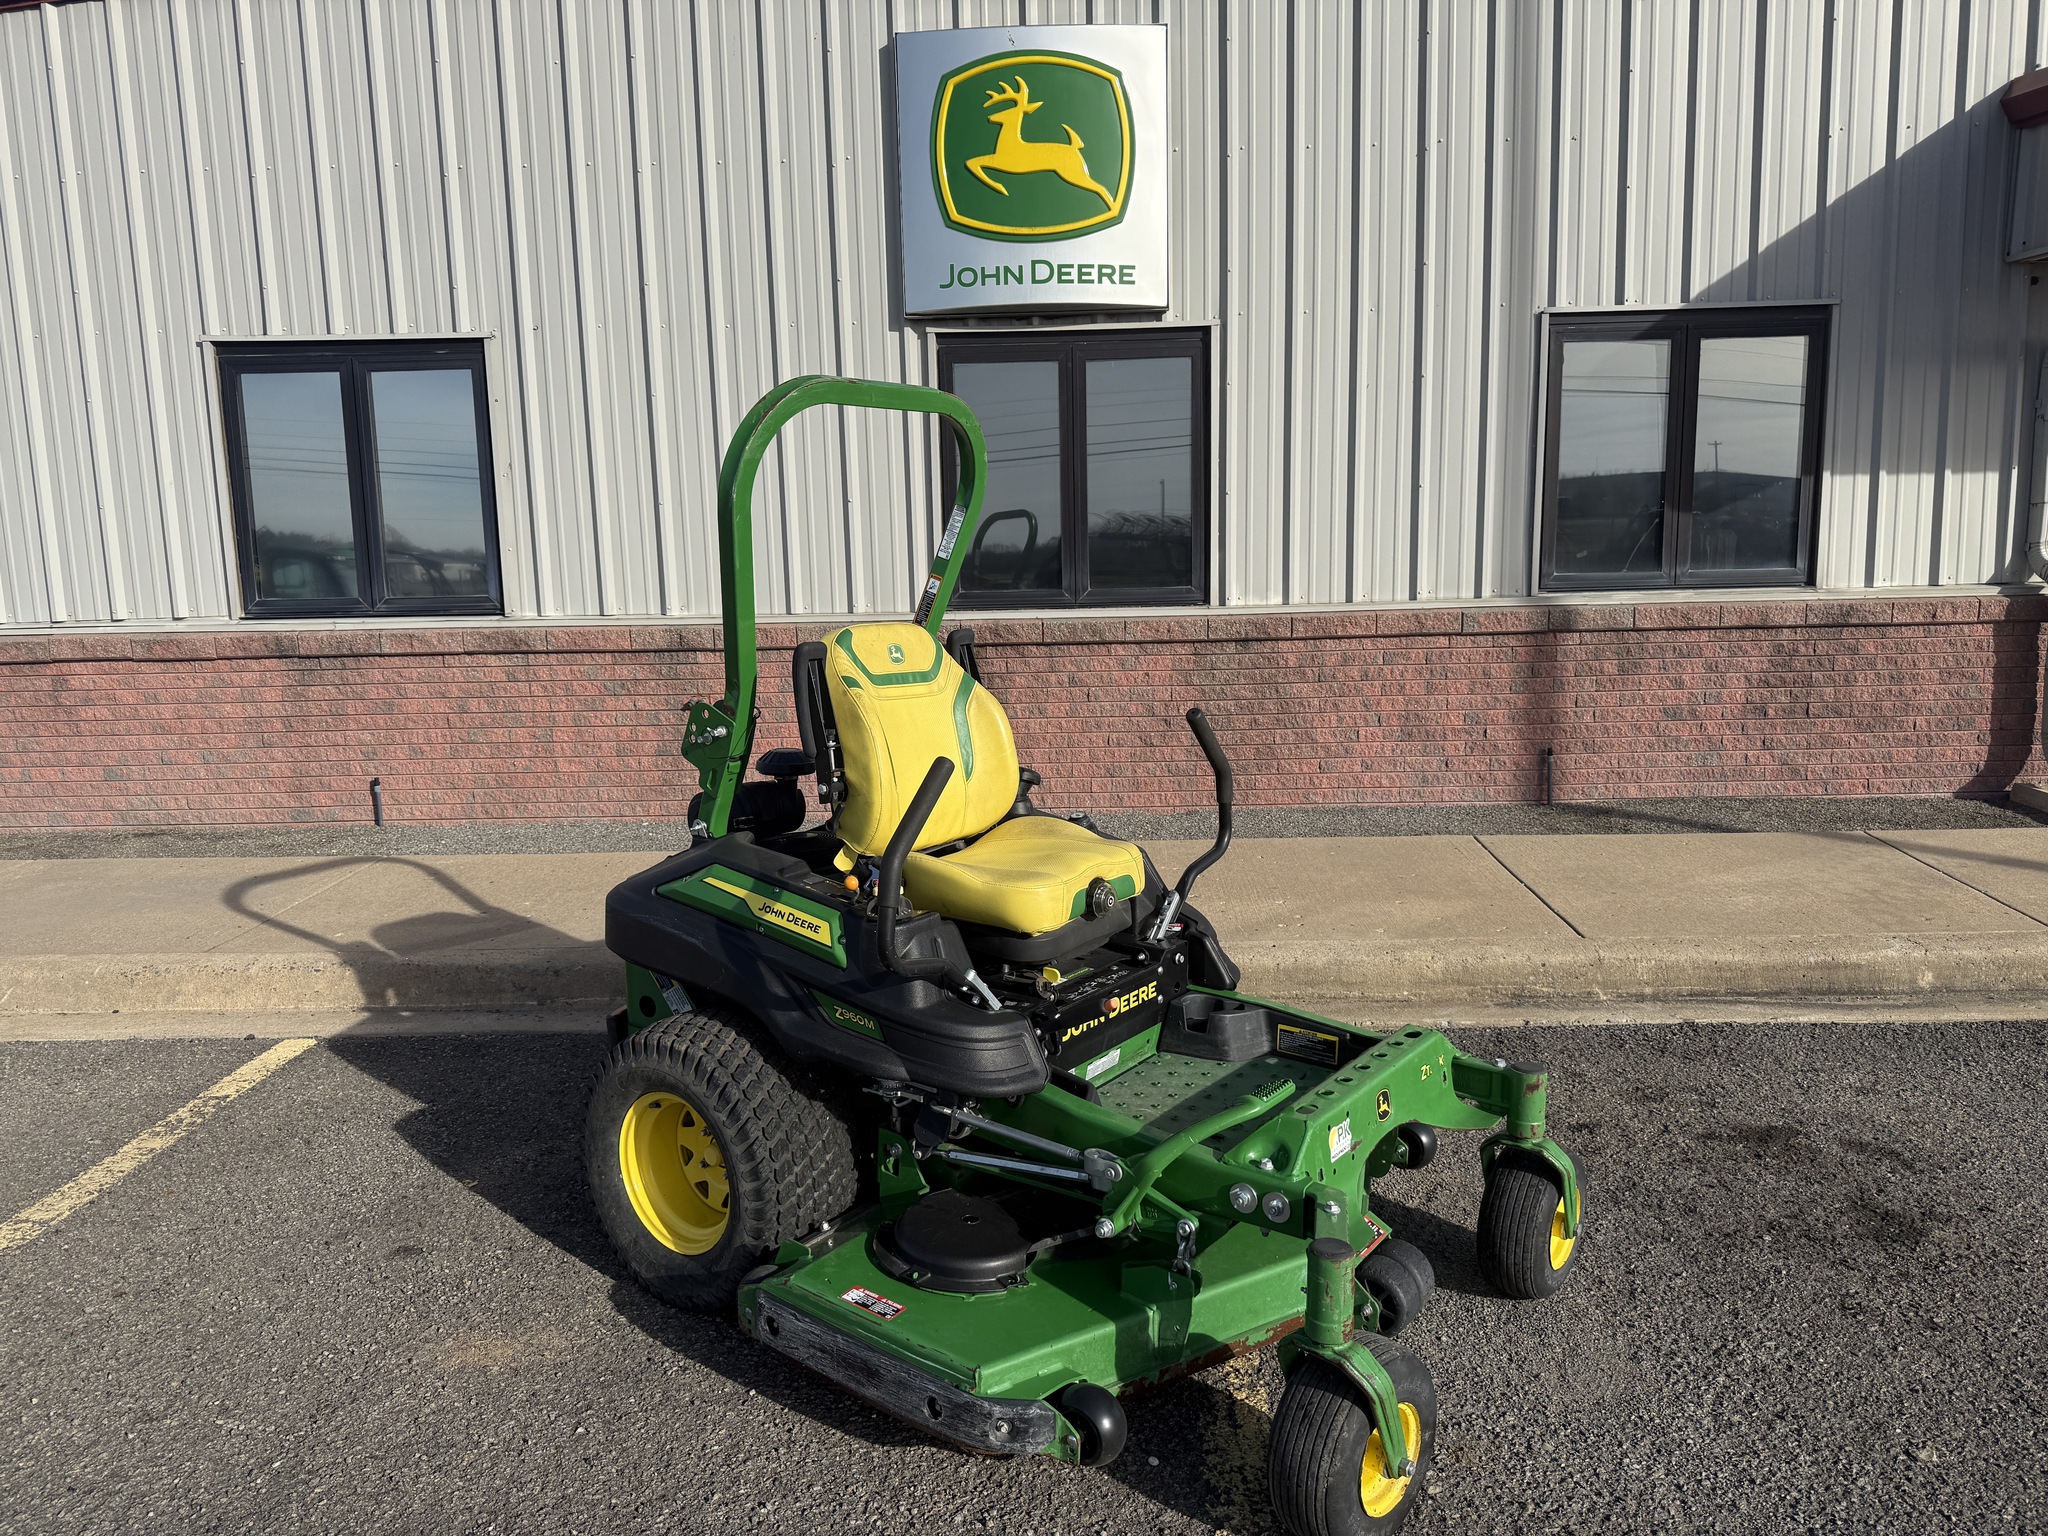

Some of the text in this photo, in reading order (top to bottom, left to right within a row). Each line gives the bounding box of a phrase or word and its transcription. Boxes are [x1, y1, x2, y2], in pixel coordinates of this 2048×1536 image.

[939, 259, 1136, 289] JOHN DEERE
[758, 902, 821, 934] JOHN DEERE
[1108, 980, 1157, 1019] DEERE
[833, 1005, 875, 1030] Z960M
